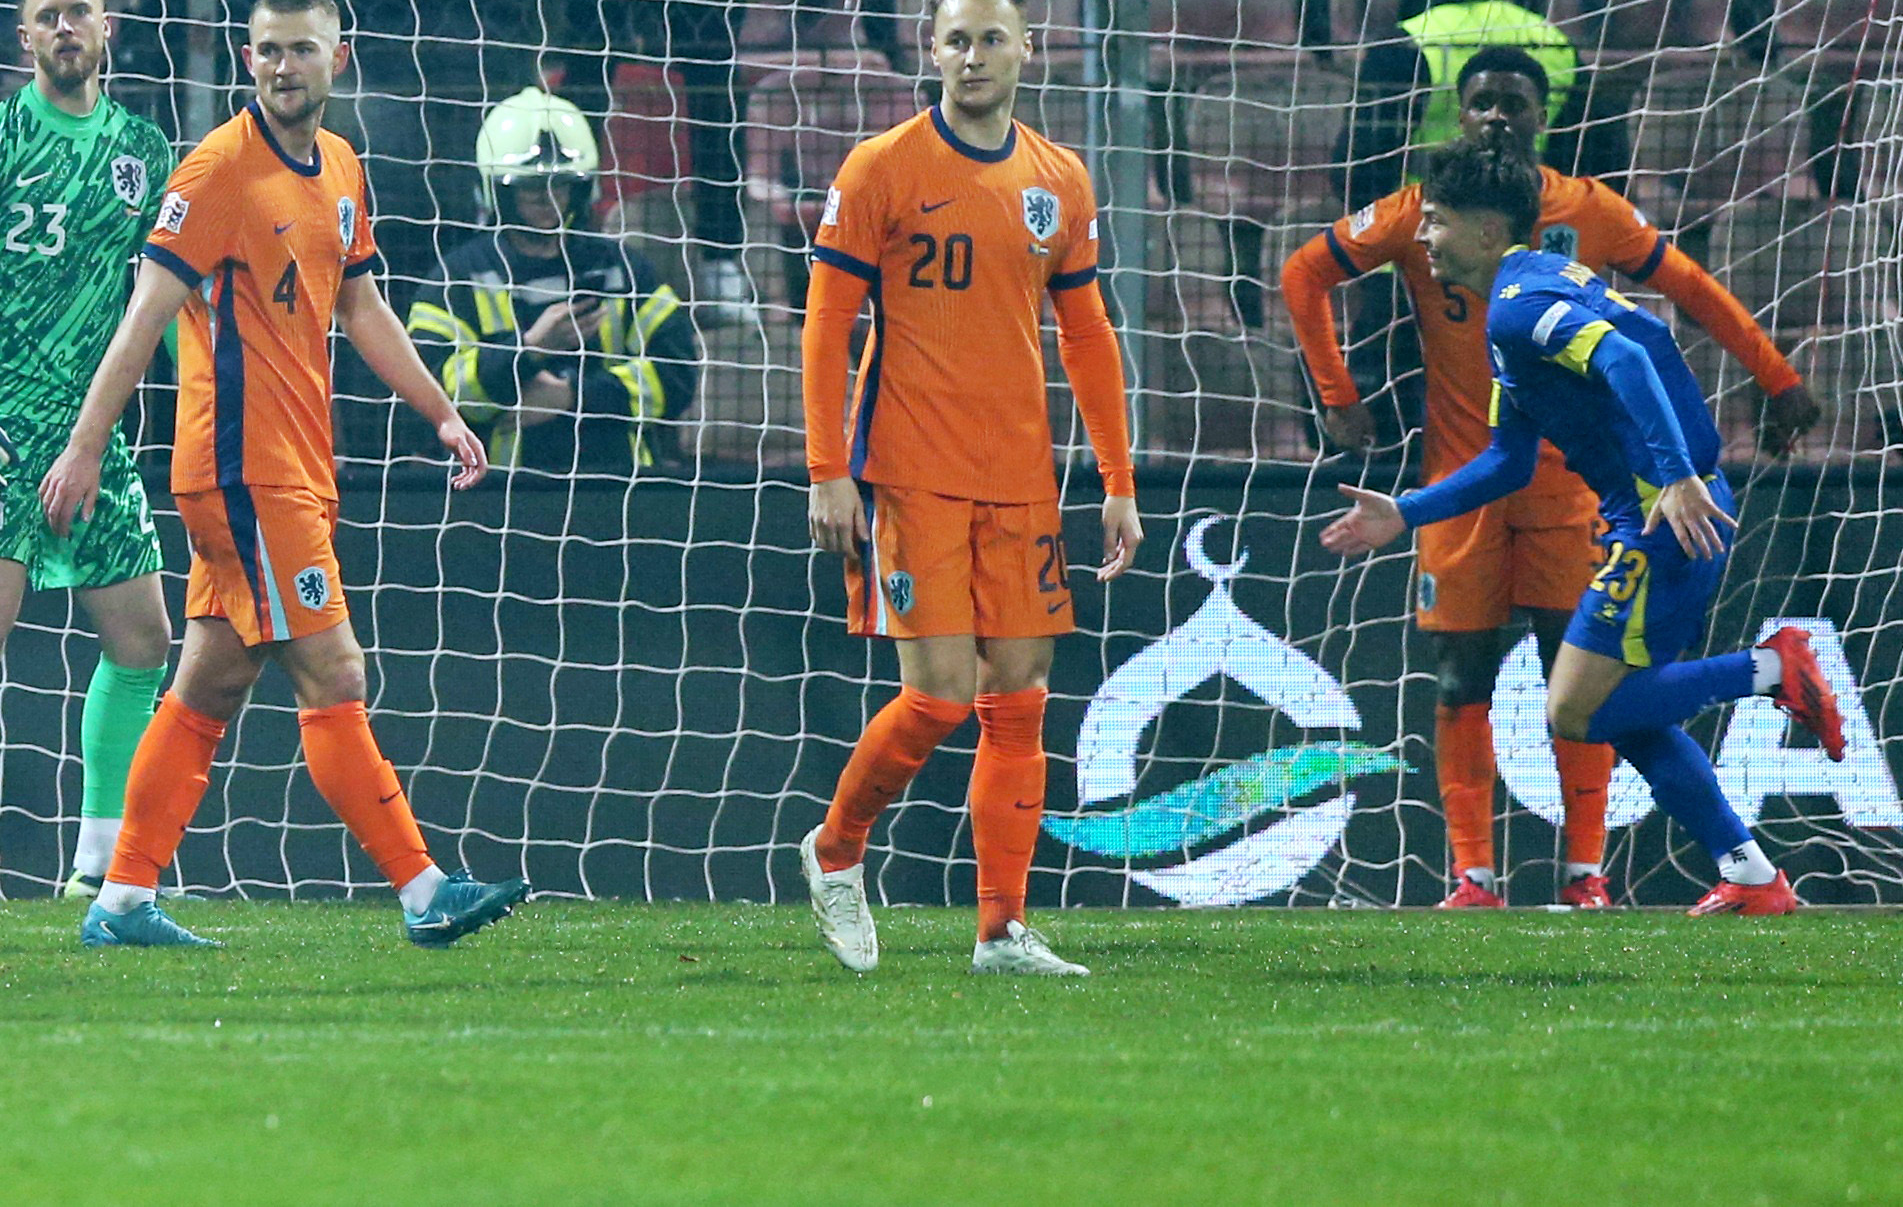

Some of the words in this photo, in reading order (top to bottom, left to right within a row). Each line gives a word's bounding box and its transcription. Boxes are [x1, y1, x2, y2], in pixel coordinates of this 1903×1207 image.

[5, 202, 68, 257] 23
[272, 259, 297, 315] 4
[908, 233, 973, 291] 20
[1441, 280, 1468, 323] 5
